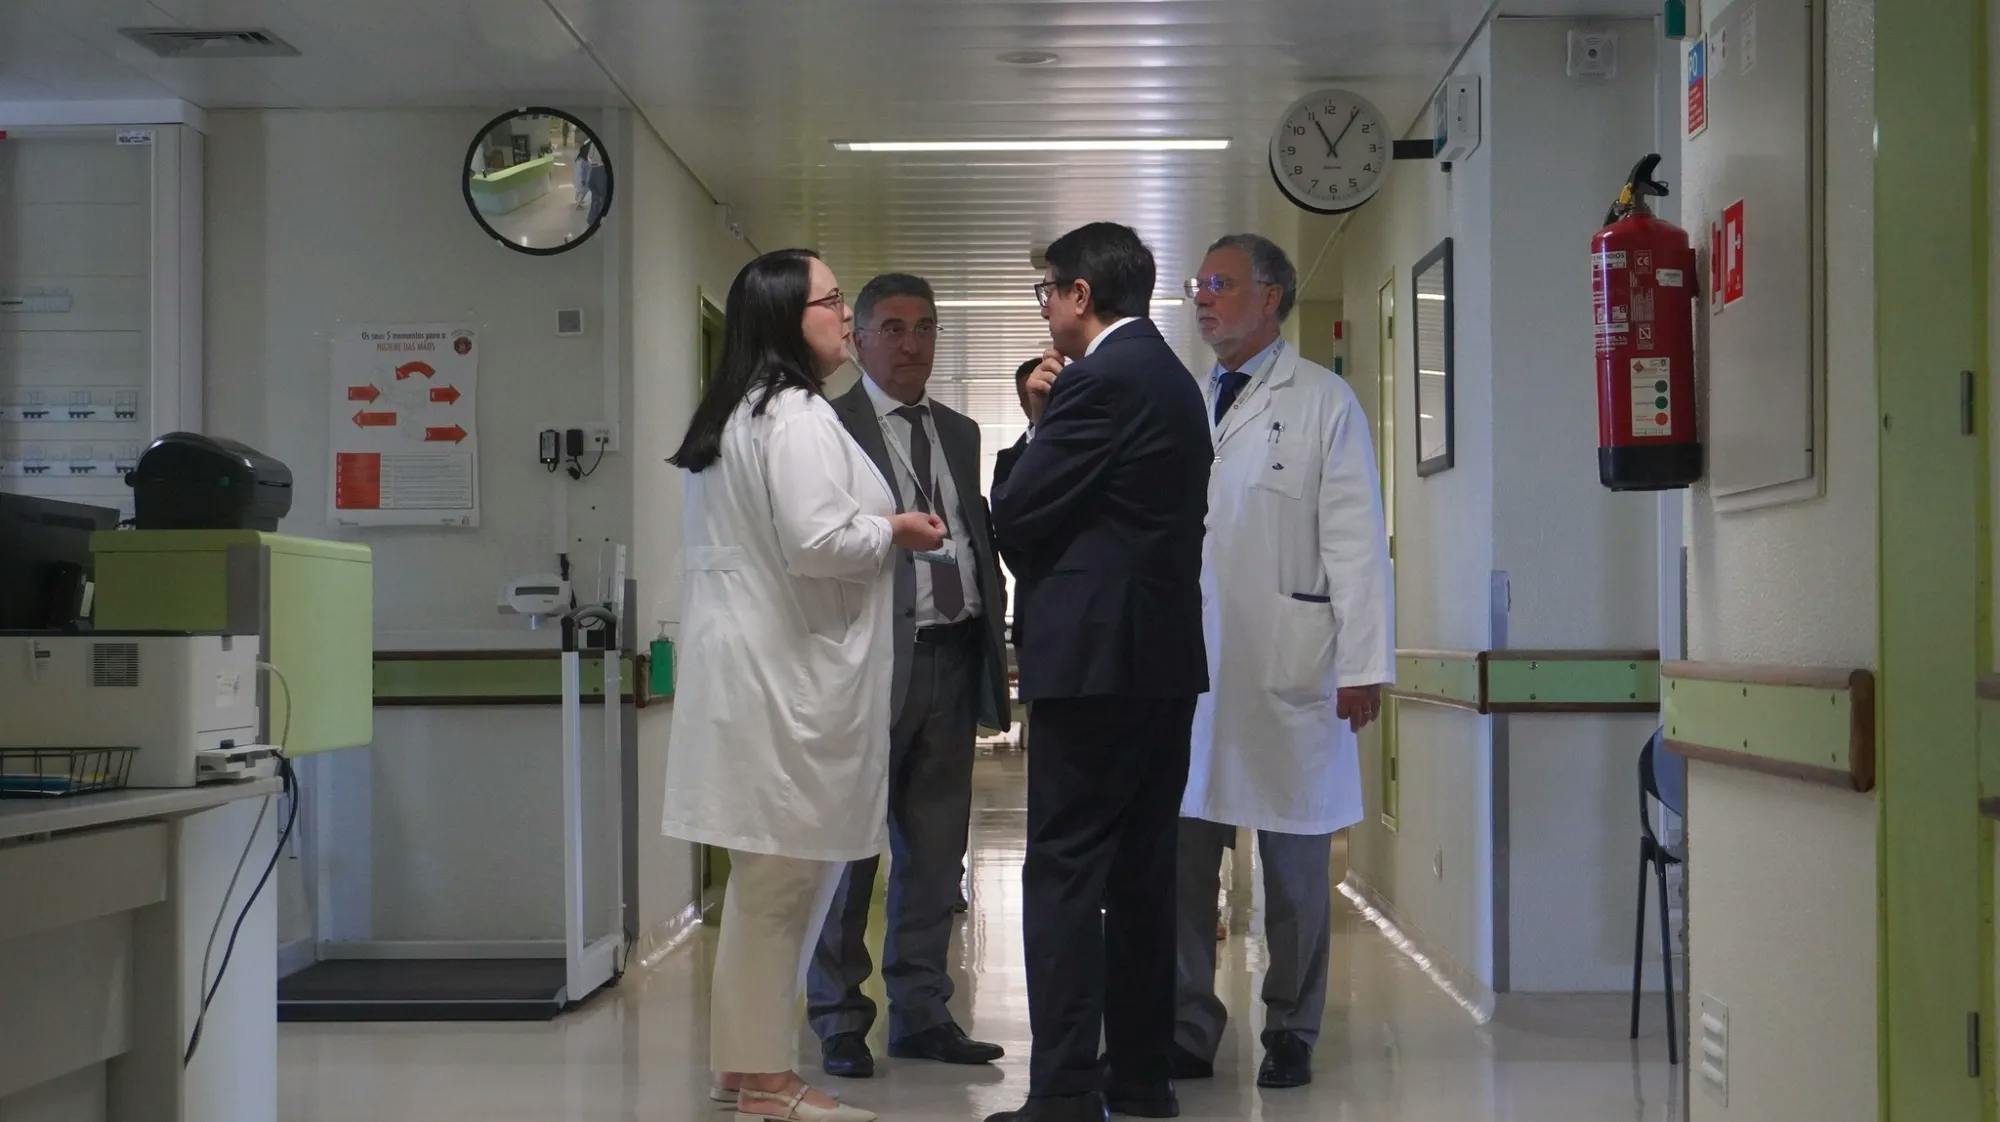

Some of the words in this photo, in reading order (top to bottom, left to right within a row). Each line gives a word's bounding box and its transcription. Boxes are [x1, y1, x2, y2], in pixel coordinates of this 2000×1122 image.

[1324, 105, 1336, 115] 12
[1308, 112, 1315, 121] 11
[1293, 126, 1305, 136] 10
[1361, 124, 1370, 134] 2
[1287, 146, 1296, 156] 9
[1369, 144, 1377, 153] 3
[1294, 166, 1303, 175] 8
[1363, 162, 1372, 172] 4
[1311, 179, 1320, 188] 7
[1348, 178, 1358, 188] 5
[1329, 184, 1338, 194] 6
[1637, 256, 1649, 266] CE
[361, 332, 370, 340] Os
[386, 331, 392, 340] 5
[403, 342, 416, 352] DAS
